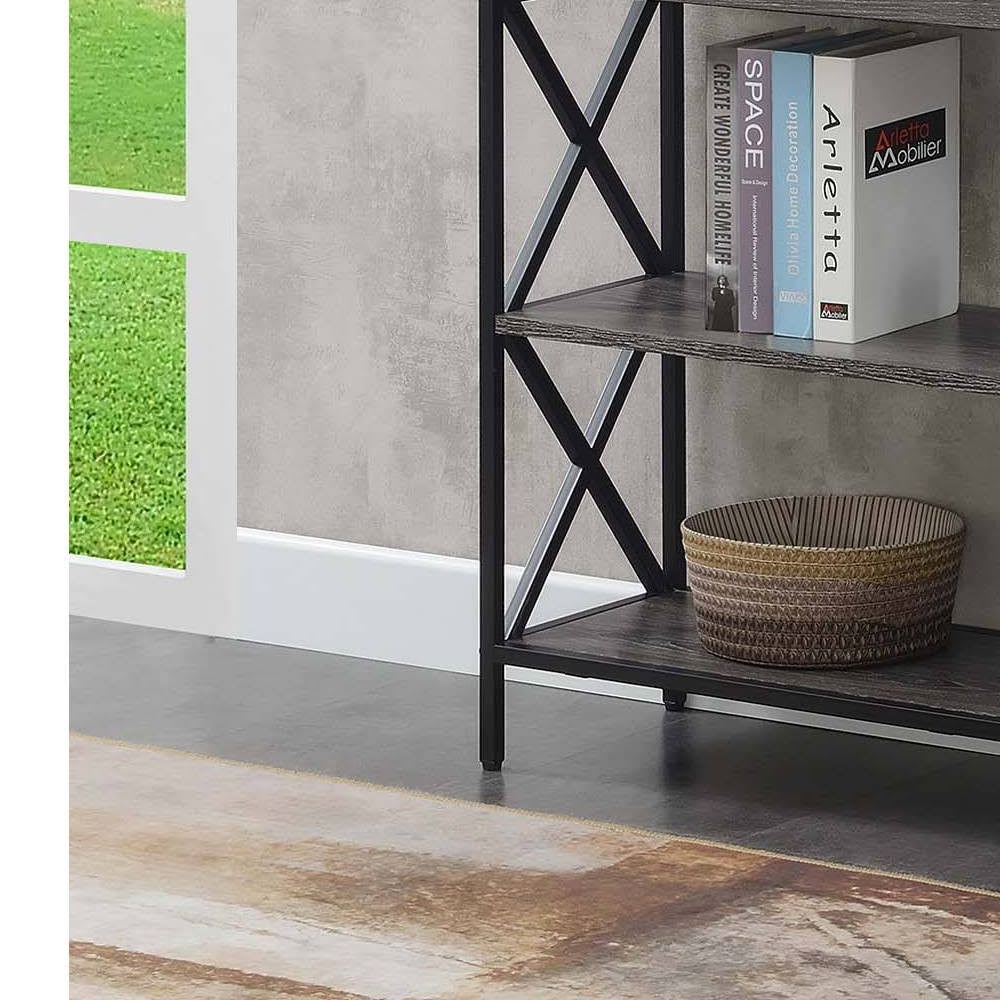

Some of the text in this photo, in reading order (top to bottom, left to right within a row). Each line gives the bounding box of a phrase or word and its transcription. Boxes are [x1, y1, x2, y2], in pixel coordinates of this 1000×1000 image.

[744, 58, 764, 169] SPACE
[786, 101, 799, 184] Decoration
[875, 121, 930, 152] Arletta
[713, 63, 732, 266] CREATE WONDERFUL HOMELIFE
[822, 104, 843, 273] Arletta
[868, 138, 942, 174] Mobilier
[786, 187, 799, 229] Home
